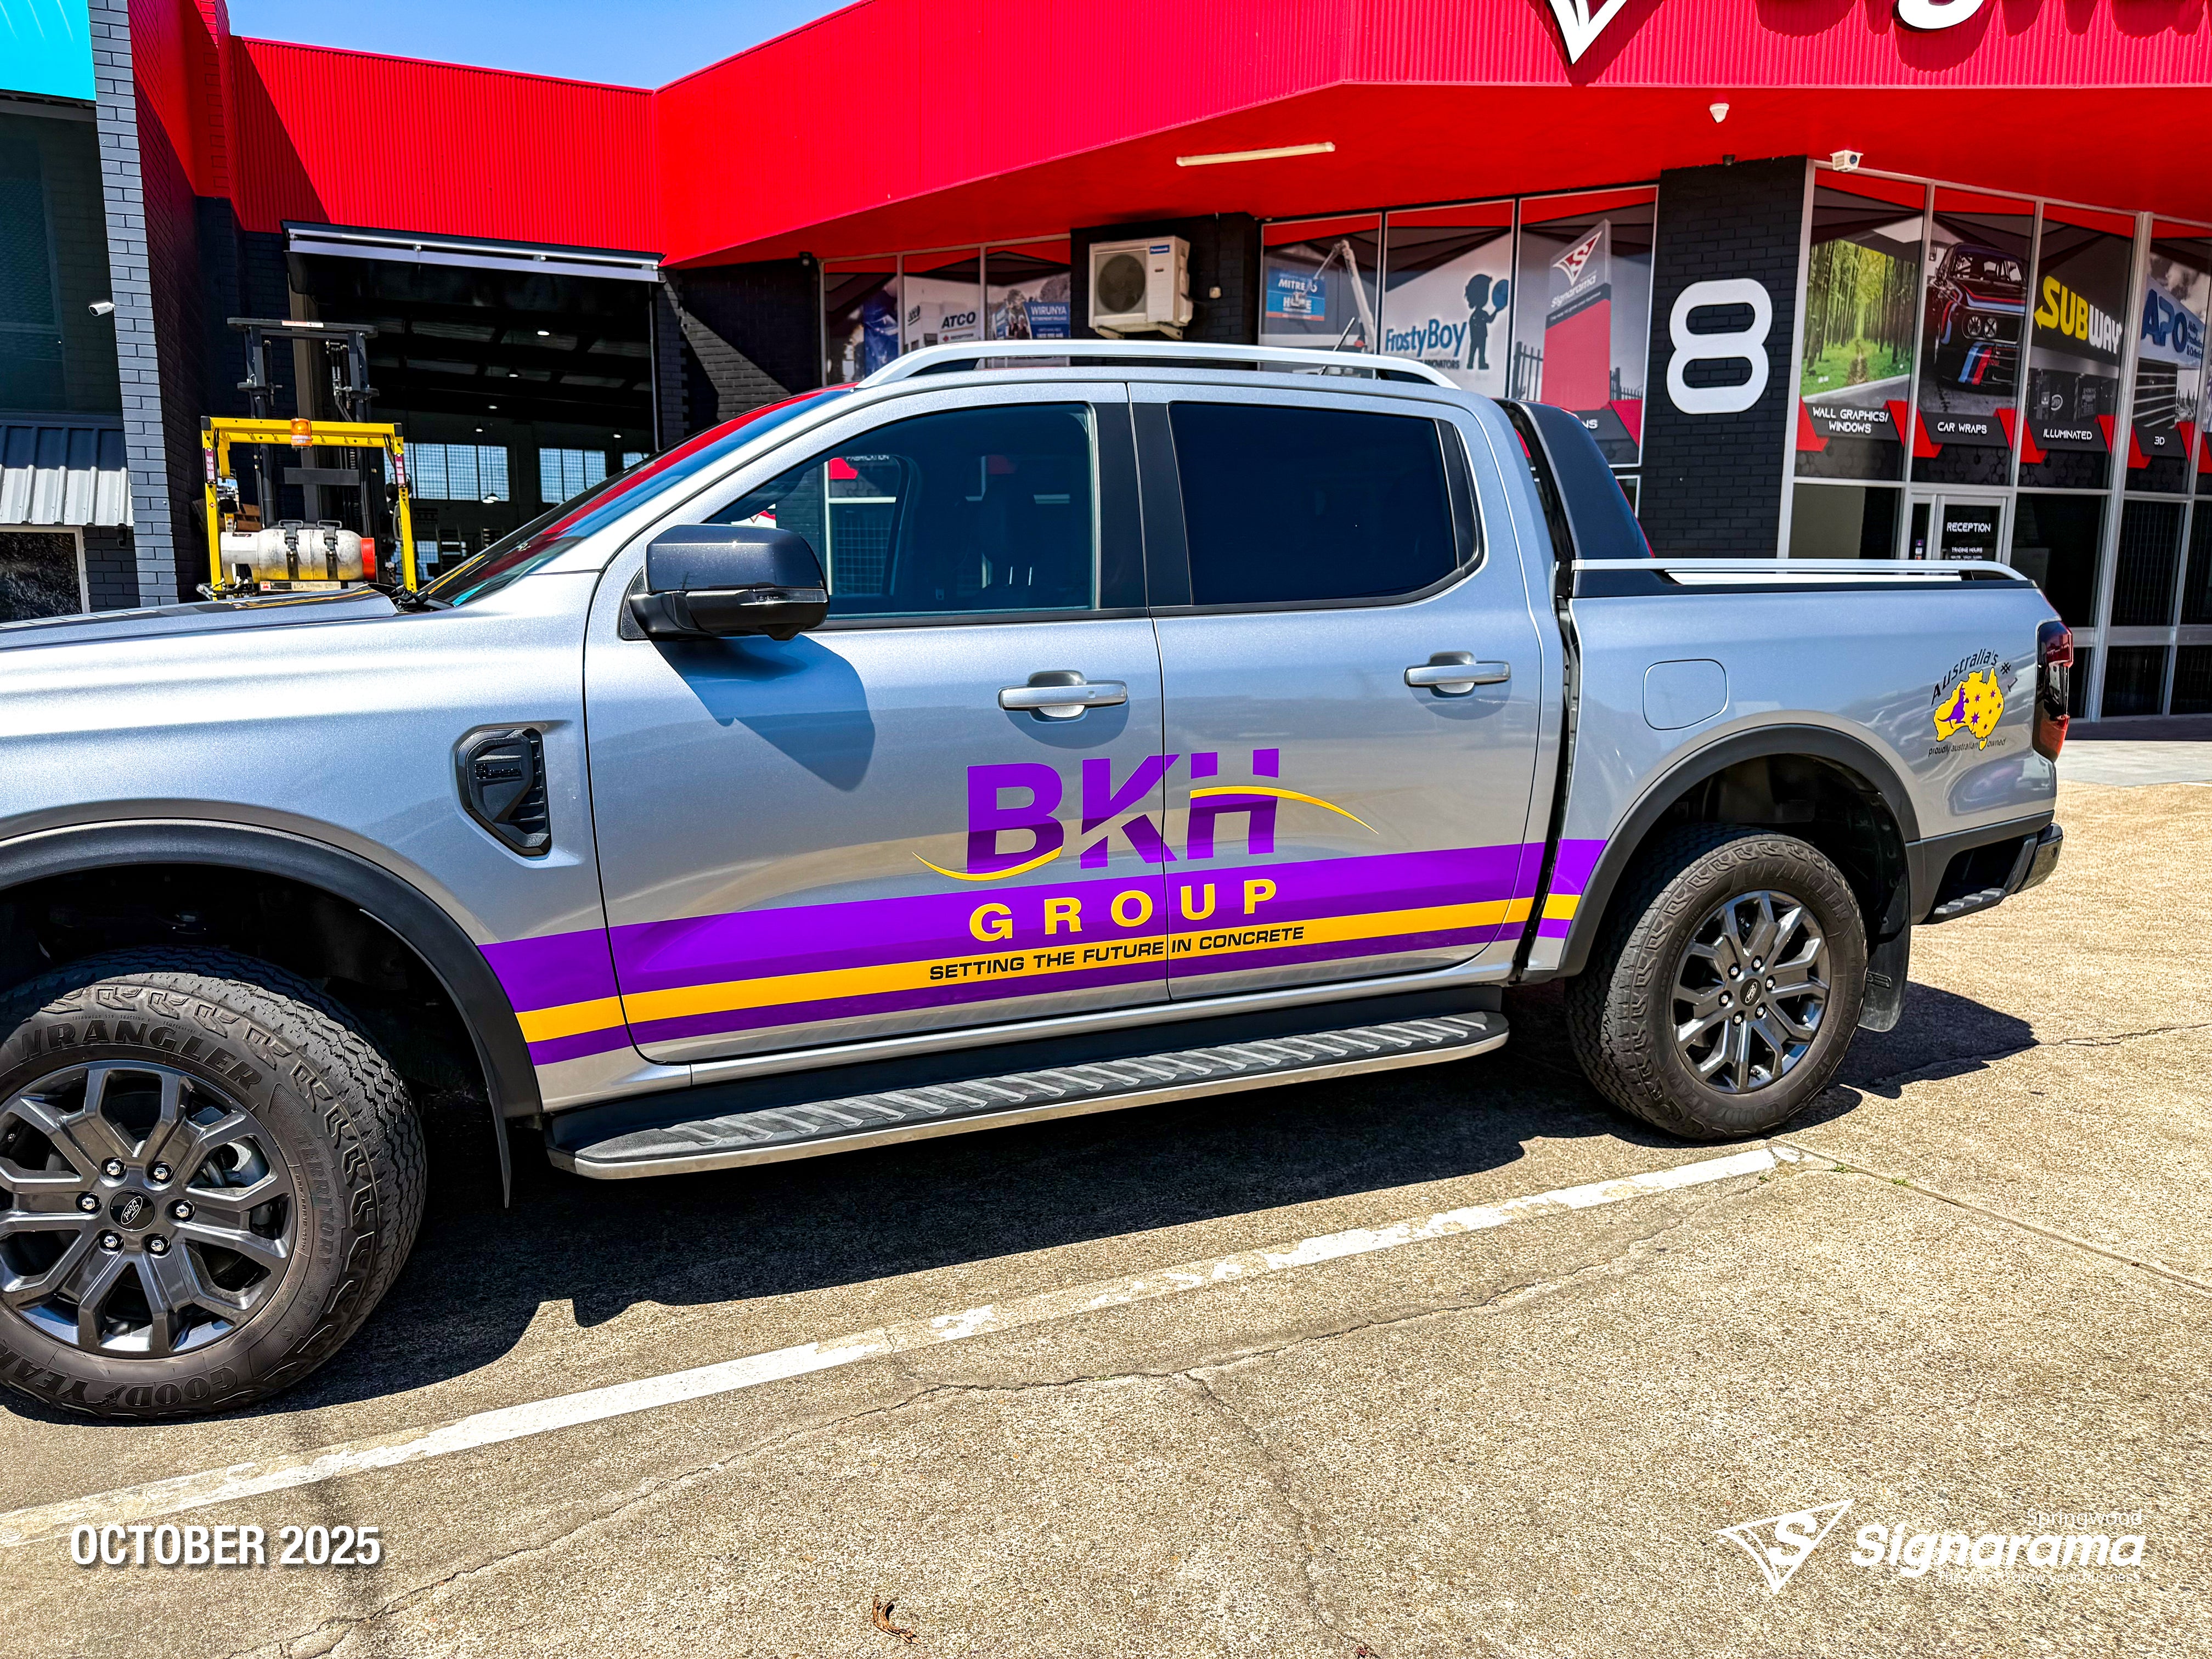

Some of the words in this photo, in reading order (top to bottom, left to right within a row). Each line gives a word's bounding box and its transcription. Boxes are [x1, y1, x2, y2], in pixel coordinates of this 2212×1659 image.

[1278, 278, 1305, 290] MITRE
[1030, 306, 1067, 315] WIRUNYA
[2034, 275, 2123, 354] SUBWAY
[941, 311, 976, 329] ATCO
[1666, 278, 1773, 415] 8
[1812, 406, 1837, 419] WALL
[1839, 409, 1889, 423] GRAPHICS/
[1829, 420, 1872, 434] WINDOWS
[1937, 421, 1955, 432] CAR
[1958, 423, 1988, 434] WRAPS
[2043, 428, 2092, 440] ILLUMINATED
[2154, 436, 2165, 445] 3D
[1946, 522, 1991, 533] RECEPTION
[1931, 648, 1999, 707] Australia's
[1928, 743, 1951, 758] proudly
[1951, 740, 1978, 752] australian
[1987, 737, 2007, 748] owned
[967, 748, 1279, 874] BKH
[969, 878, 1277, 942] GROUP
[929, 957, 1025, 980] SETTING
[1033, 951, 1075, 968] THE
[1082, 941, 1164, 963] FUTURE
[1171, 938, 1192, 953] IN
[1199, 926, 1305, 950] CONCRETE
